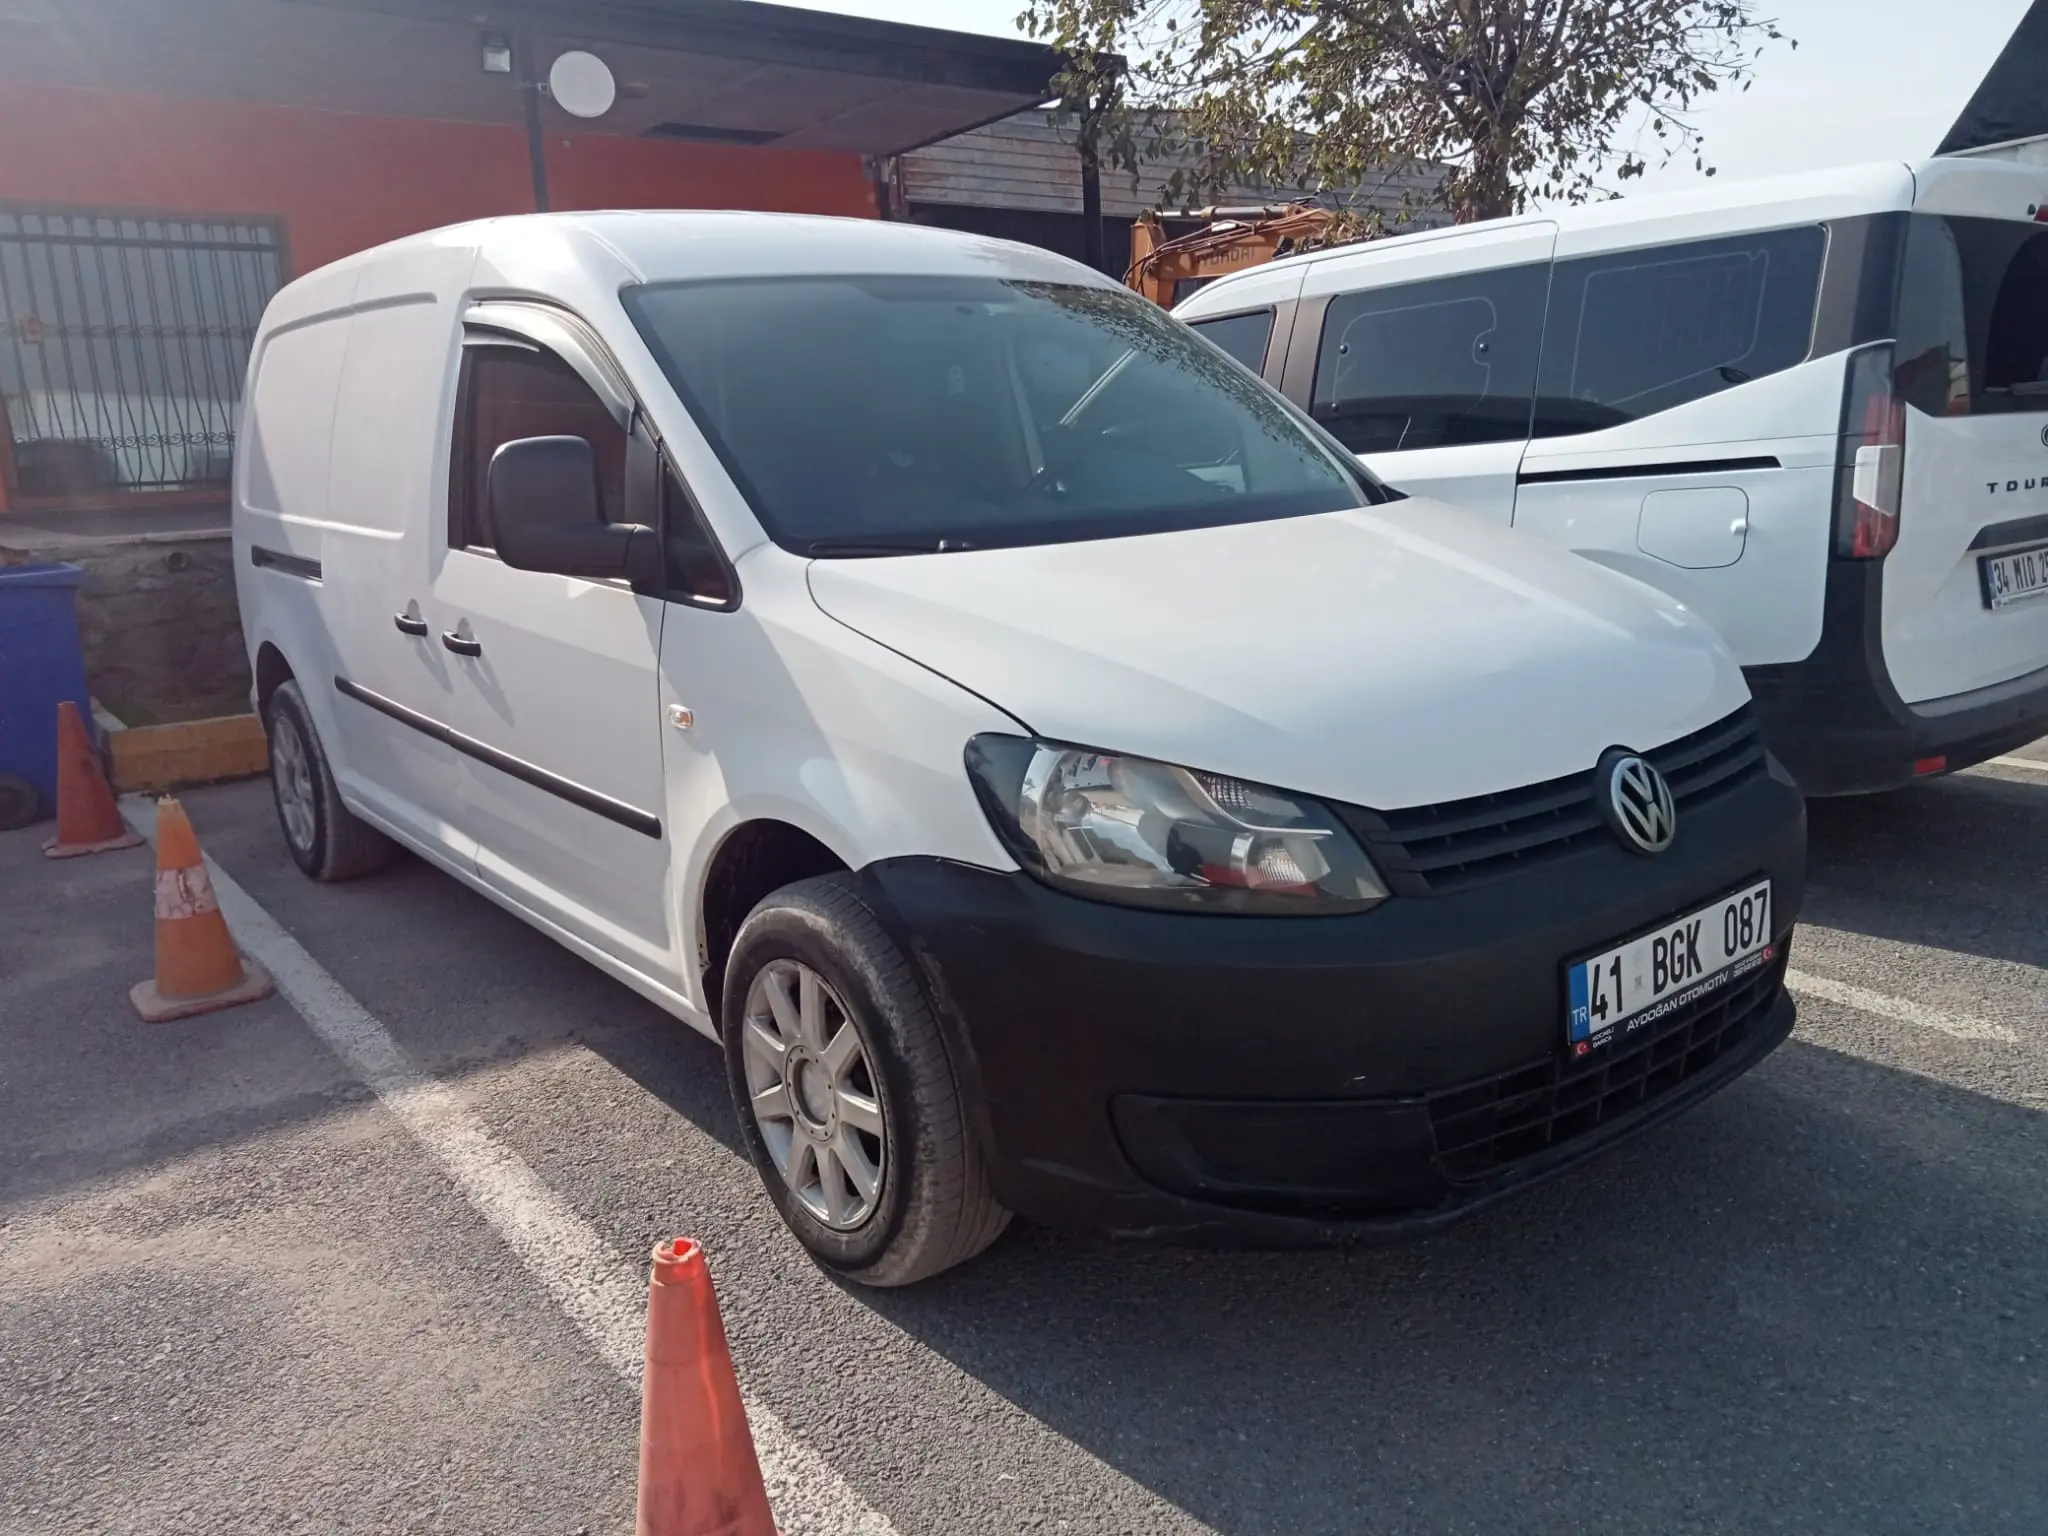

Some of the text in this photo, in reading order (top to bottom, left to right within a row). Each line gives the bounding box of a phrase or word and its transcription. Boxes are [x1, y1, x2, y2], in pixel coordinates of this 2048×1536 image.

[1994, 560, 2010, 595] 34
[1590, 887, 1768, 1021] 41 BGK 087
[1572, 1006, 1588, 1026] TR
[1626, 970, 1729, 1032] AYDOĞAN OTOMOTİV
